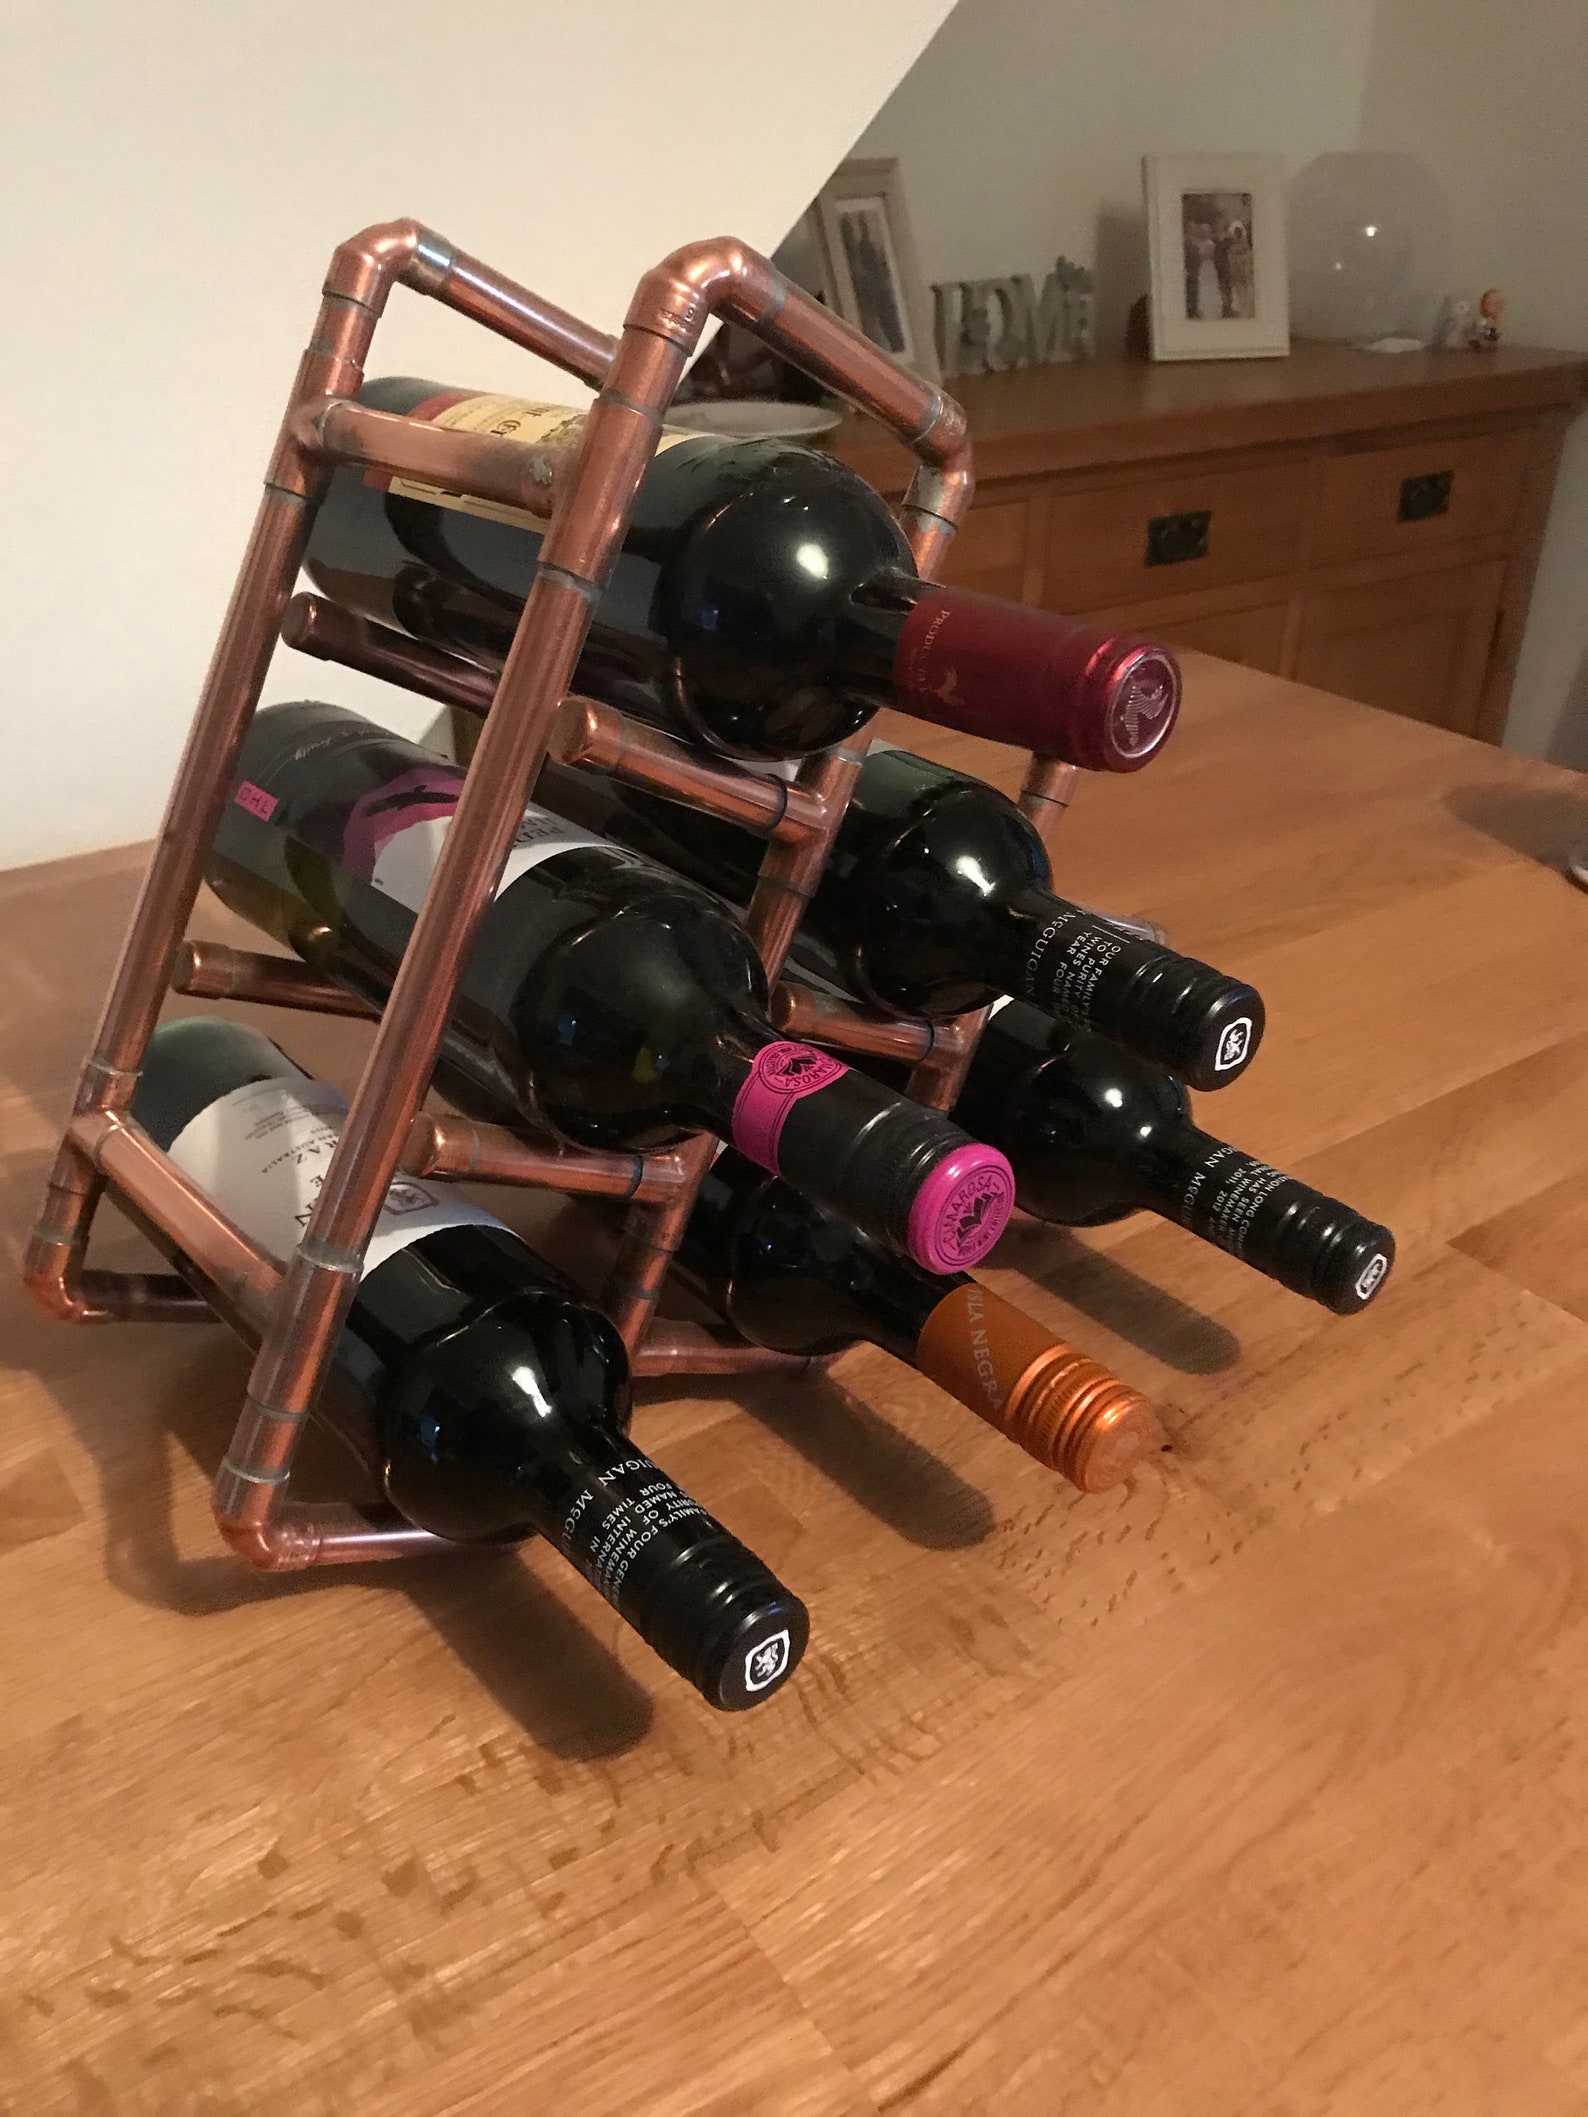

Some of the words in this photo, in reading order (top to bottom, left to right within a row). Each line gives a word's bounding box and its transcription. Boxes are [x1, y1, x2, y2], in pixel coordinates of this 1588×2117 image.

[930, 260, 1096, 376] HOME
[1066, 931, 1092, 955] YEAR
[1072, 936, 1103, 966] WINES
[1096, 940, 1113, 952] TO
[1099, 945, 1122, 966] OUR
[1052, 961, 1068, 994] FOUR
[1074, 957, 1096, 998] PURITY
[1225, 1168, 1247, 1184] 2011,
[1248, 1177, 1267, 1194] HAS
[1212, 1190, 1228, 1212] 2012
[1232, 1196, 1250, 1222] SEEN
[1245, 1191, 1268, 1218] LONG
[970, 1329, 1003, 1410] NEGRA
[639, 1482, 673, 1497] FOUR
[601, 1497, 635, 1530] TIMES
[634, 1491, 677, 1514] NAMED
[642, 1509, 659, 1525] OF
[590, 1535, 600, 1552] IN
[627, 1525, 659, 1559] FOUR
